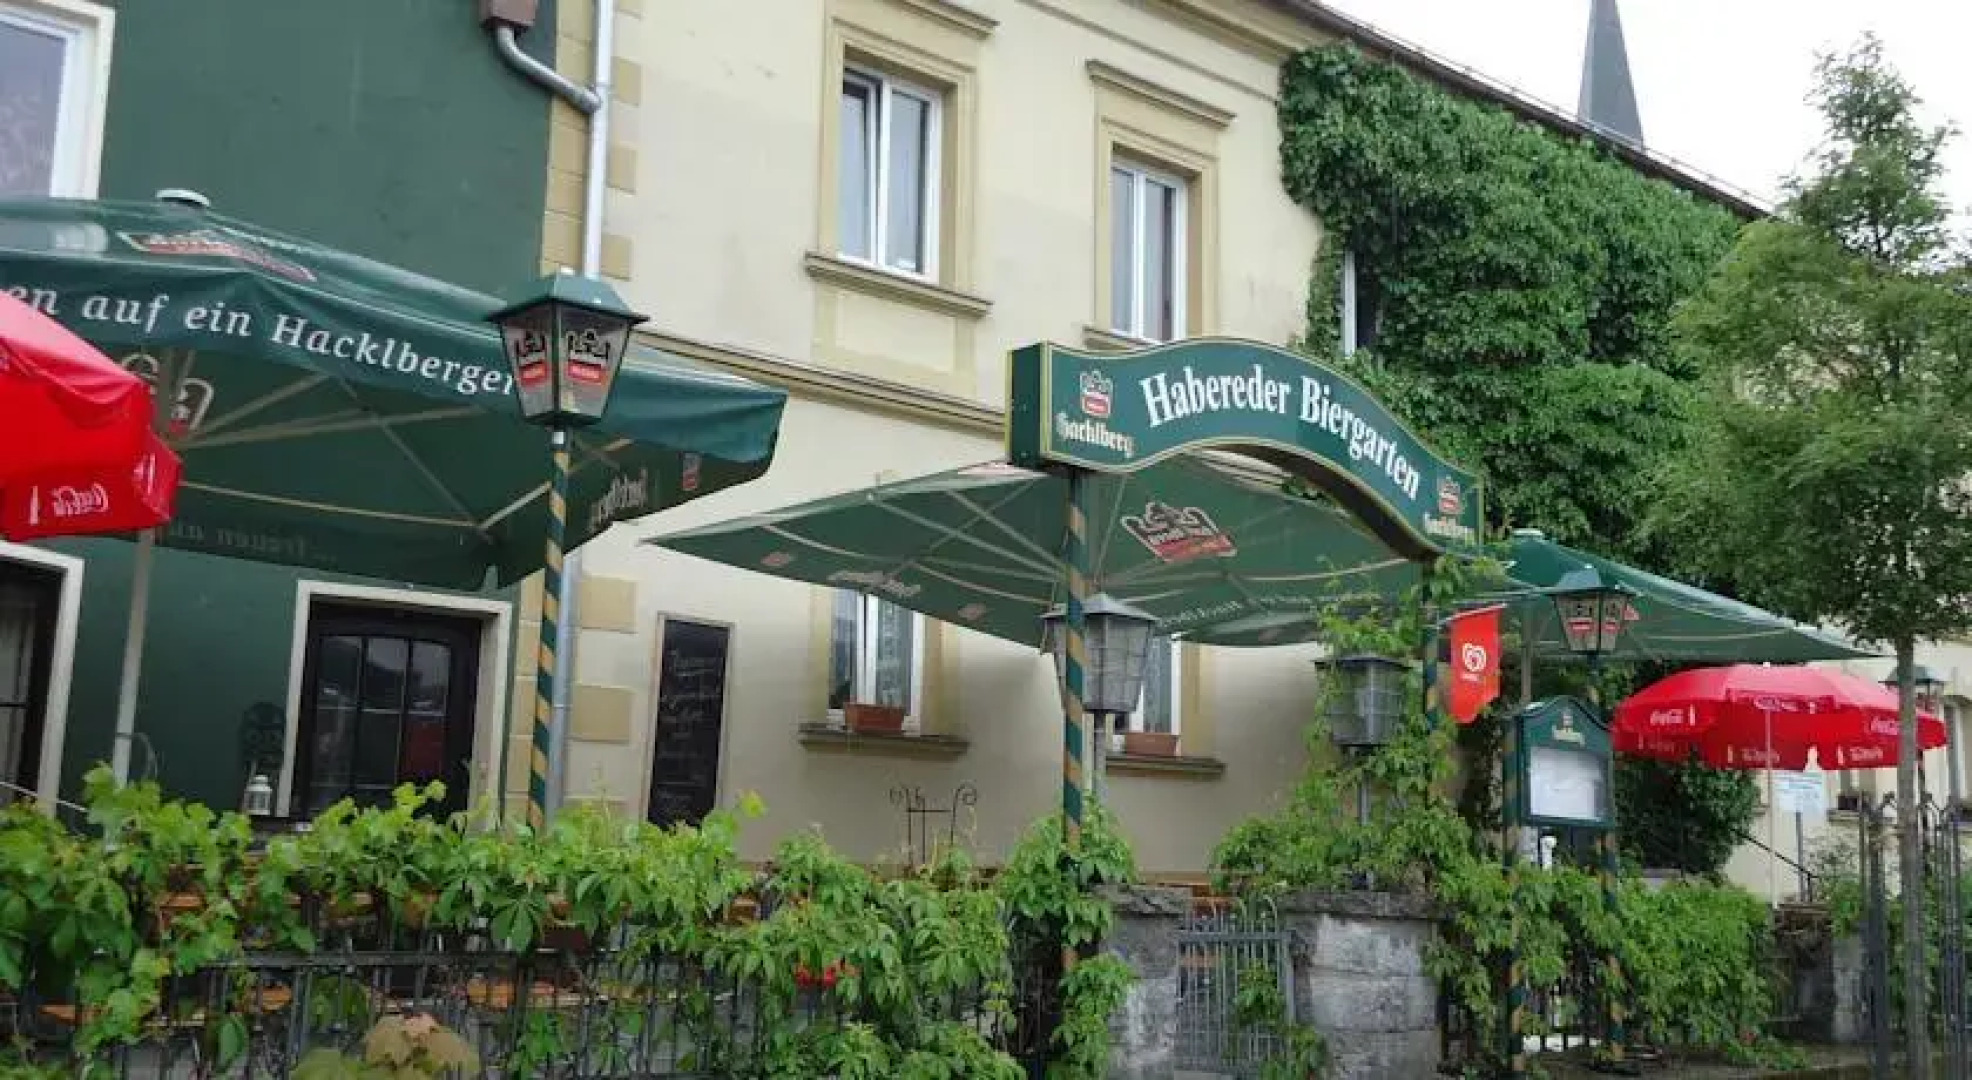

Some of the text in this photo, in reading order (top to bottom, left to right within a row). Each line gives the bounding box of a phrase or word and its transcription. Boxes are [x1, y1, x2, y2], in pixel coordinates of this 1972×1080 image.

[81, 294, 170, 333] auf
[183, 302, 252, 336] ein
[1138, 363, 1421, 501] Habereder Biergarten
